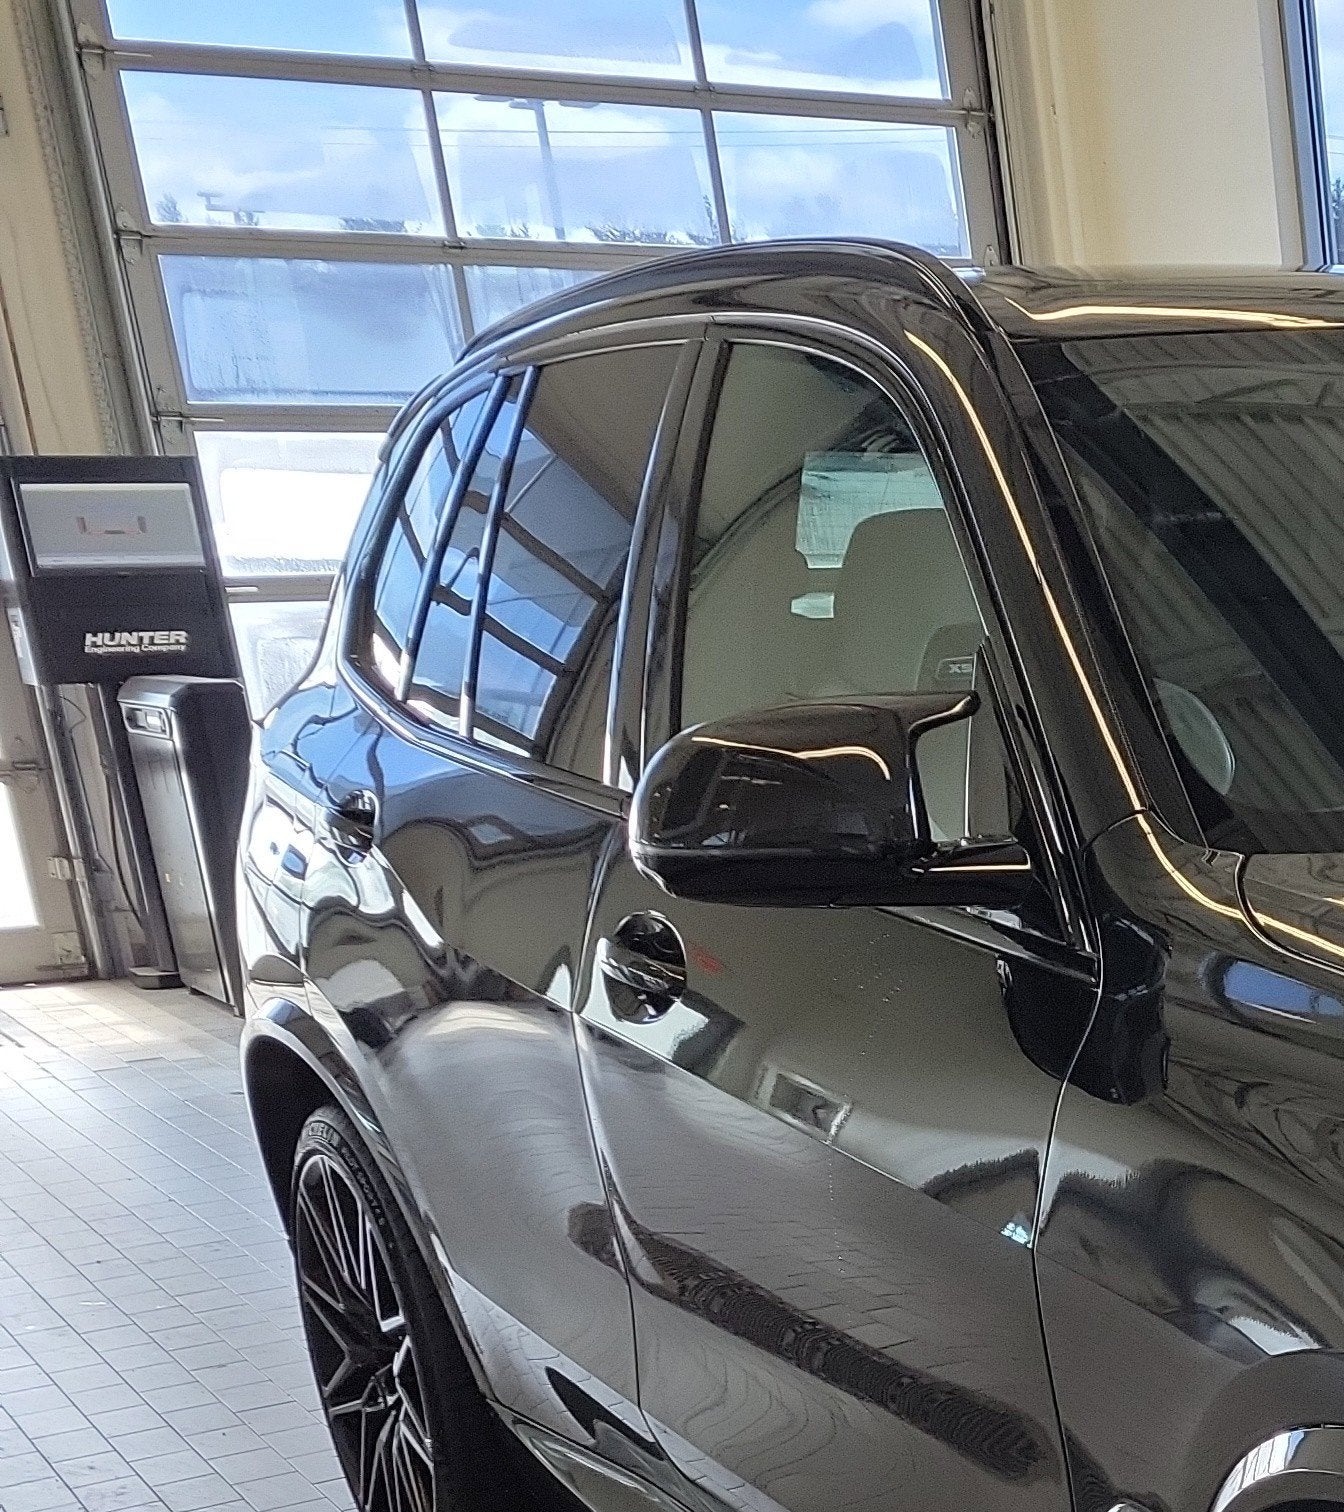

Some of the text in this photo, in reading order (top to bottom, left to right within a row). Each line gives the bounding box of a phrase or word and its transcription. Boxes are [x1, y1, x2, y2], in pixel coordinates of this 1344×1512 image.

[84, 631, 188, 645] HUNTER
[84, 642, 187, 654] Engineering Company
